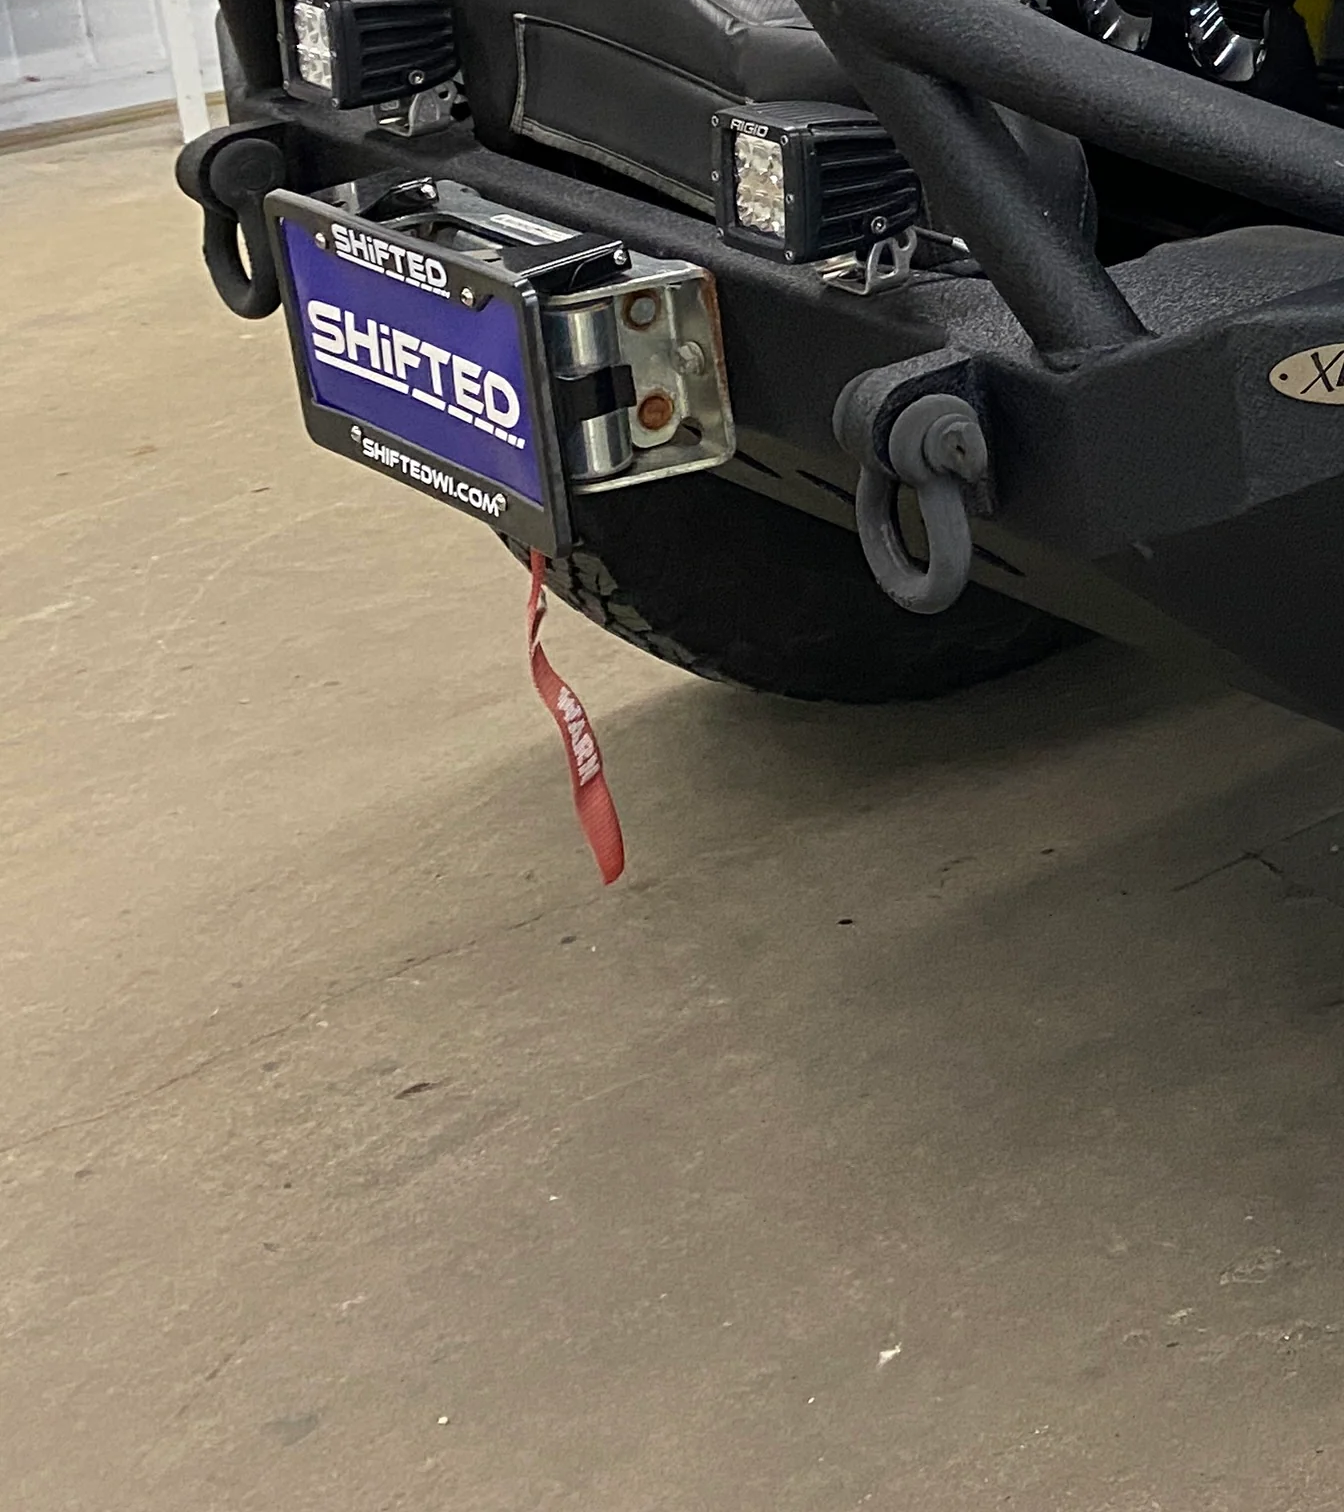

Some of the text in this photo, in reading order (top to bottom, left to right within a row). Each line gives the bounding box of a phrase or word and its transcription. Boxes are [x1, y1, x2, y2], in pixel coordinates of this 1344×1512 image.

[731, 118, 769, 138] RIGID
[362, 438, 500, 517] SHIFTEDWI.COM
[558, 687, 600, 786] WARN
